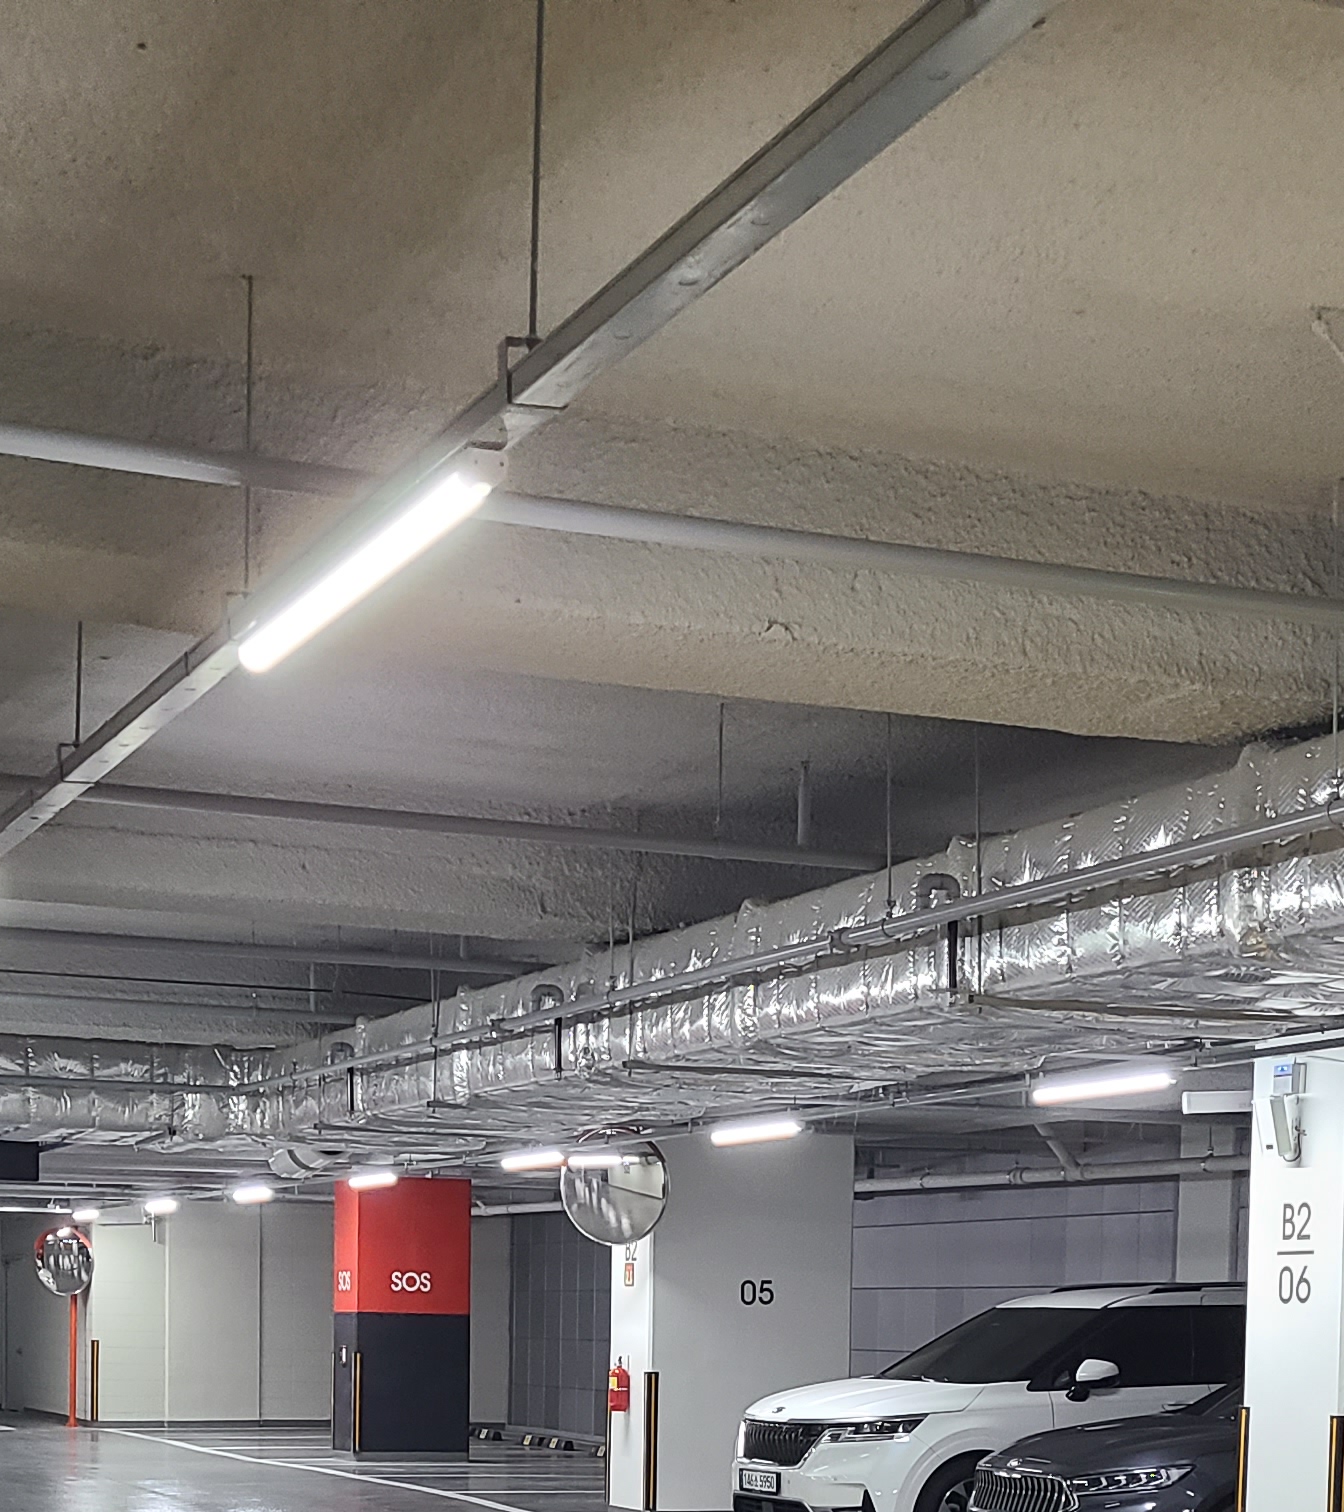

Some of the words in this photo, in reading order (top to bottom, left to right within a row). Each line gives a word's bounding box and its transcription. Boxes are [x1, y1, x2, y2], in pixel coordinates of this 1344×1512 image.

[1282, 1202, 1312, 1240] B2
[338, 1271, 351, 1291] SOS
[390, 1271, 431, 1293] SOS
[739, 1279, 774, 1306] 05
[1278, 1265, 1312, 1304] 06
